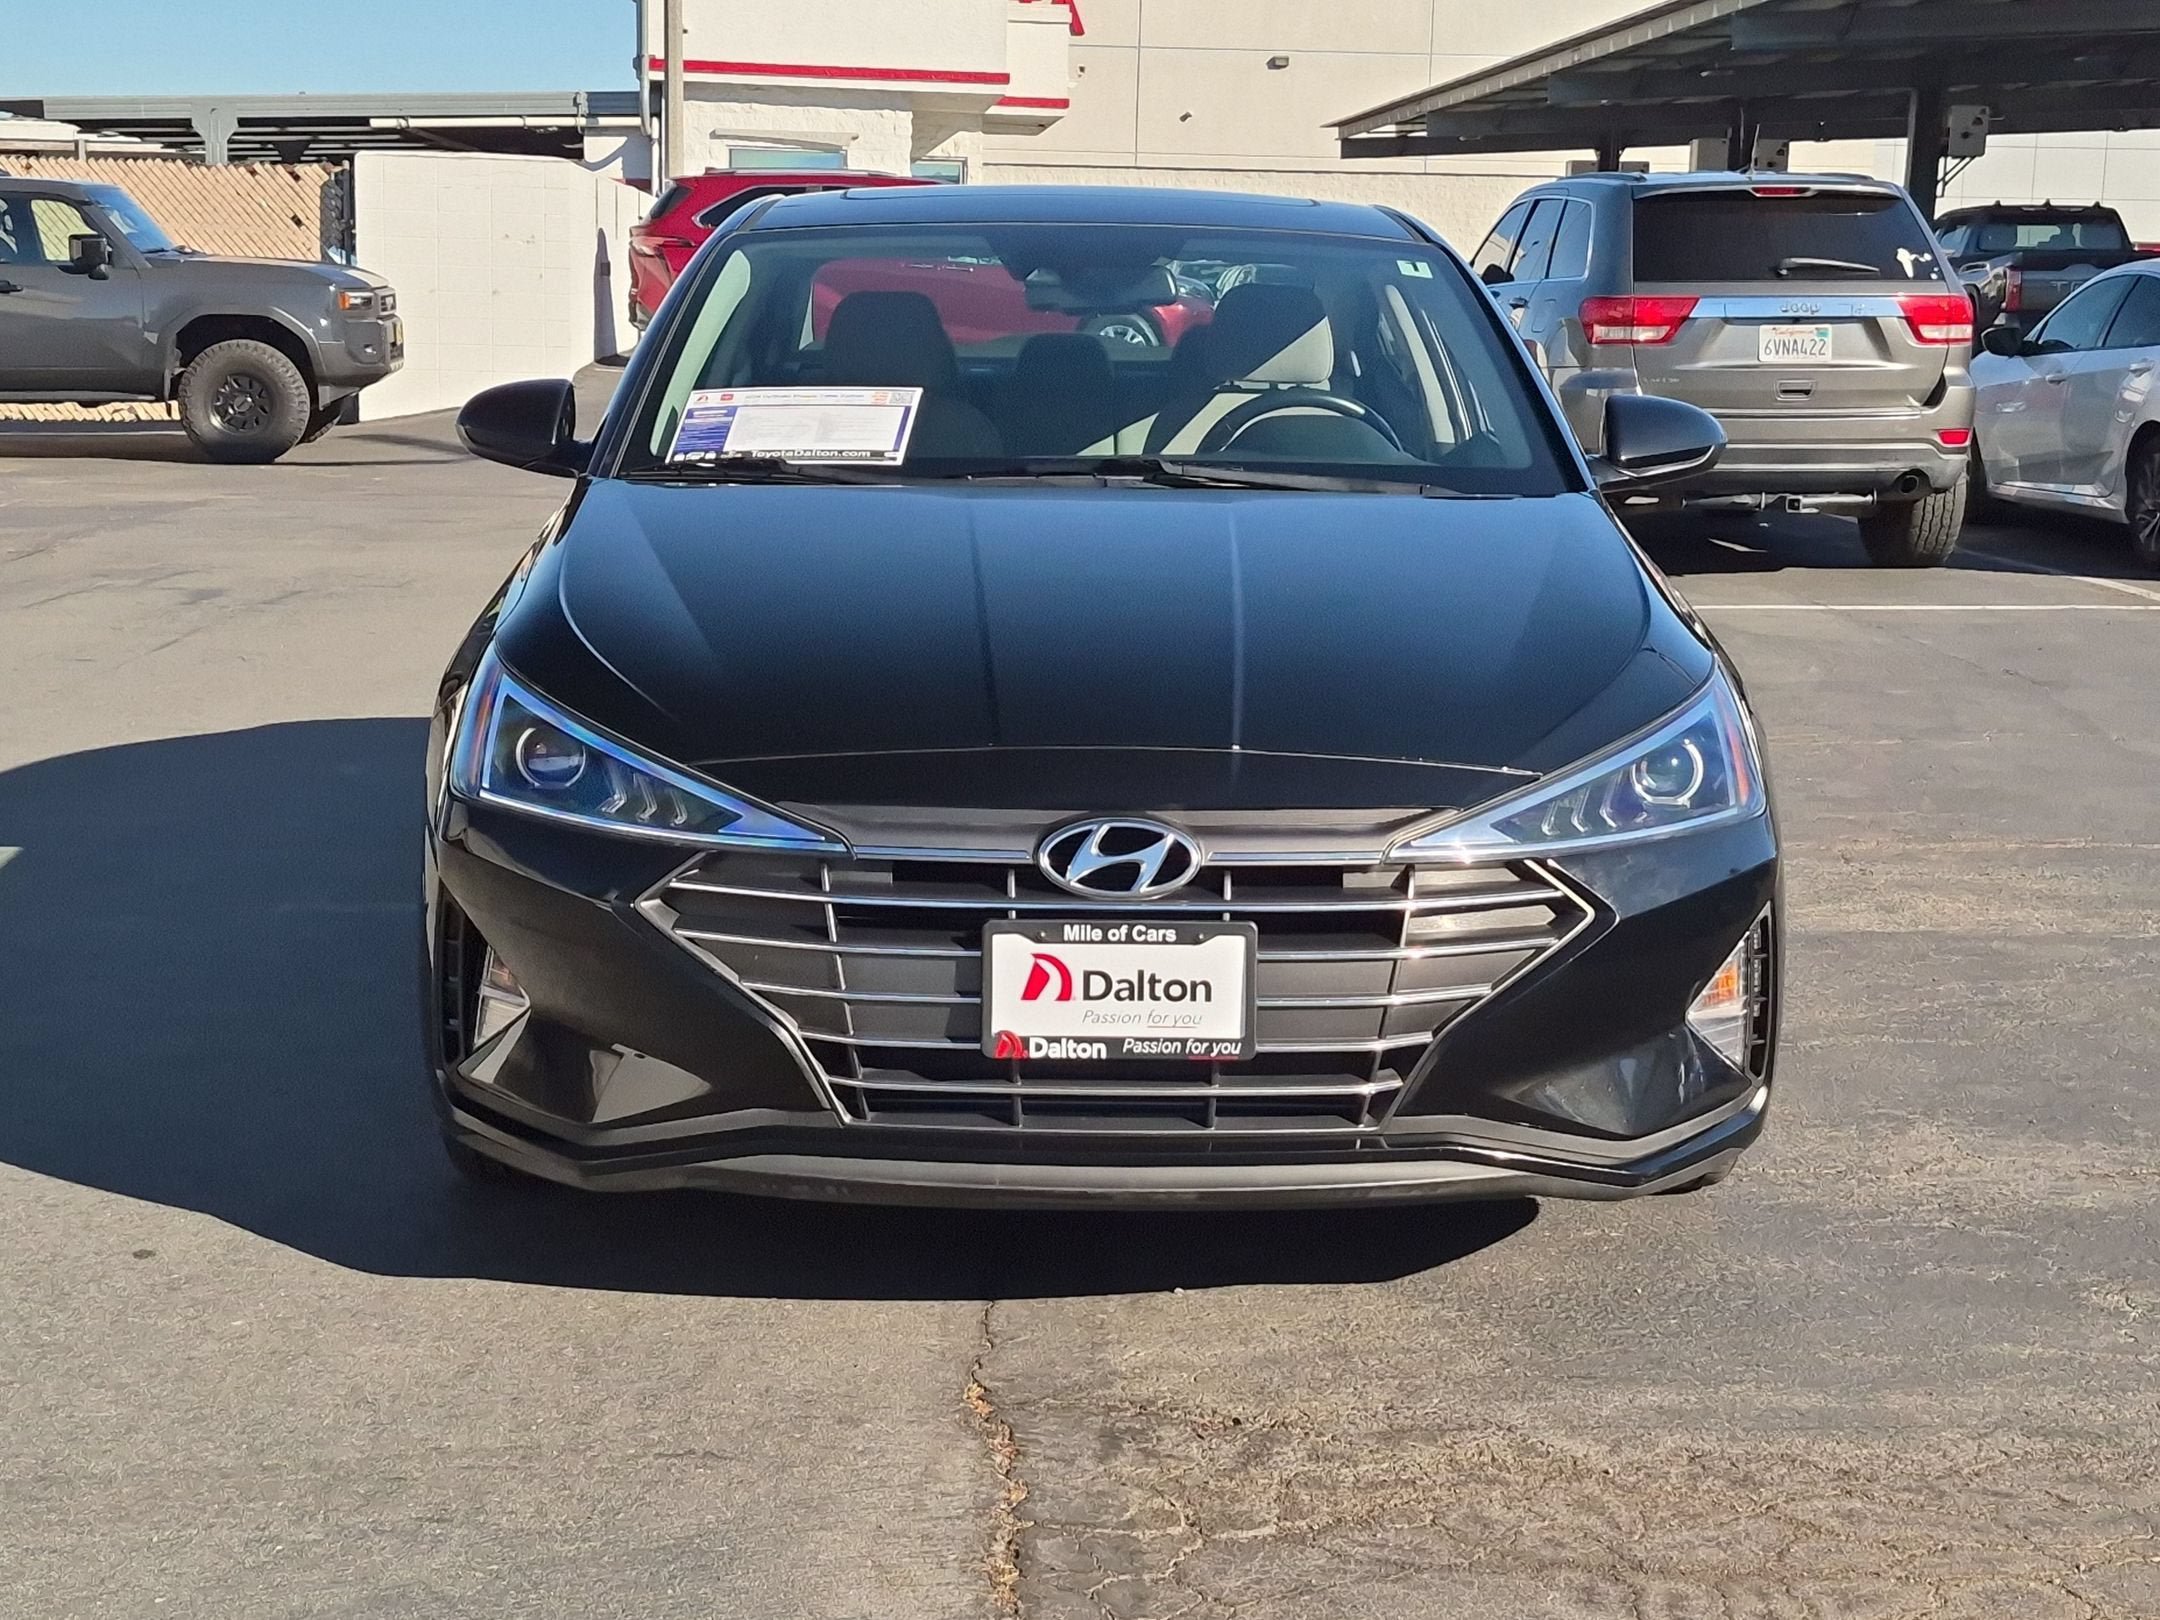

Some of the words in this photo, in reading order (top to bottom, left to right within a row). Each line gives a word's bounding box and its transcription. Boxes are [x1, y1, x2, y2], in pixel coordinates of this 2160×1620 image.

[1764, 338, 1826, 356] 6VNA422
[751, 449, 871, 459] ToyotaDalton.com
[1063, 924, 1103, 942] Mile
[1107, 924, 1128, 942] of
[1132, 924, 1177, 942] Cars
[1083, 969, 1212, 1002] Dalton
[1082, 1009, 1142, 1024] Passion
[1146, 1009, 1169, 1025] for
[1173, 1014, 1202, 1026] you
[1029, 1038, 1107, 1059] Dalton
[1122, 1038, 1181, 1054] Passion
[1185, 1039, 1209, 1055] for
[1210, 1042, 1242, 1057] you
